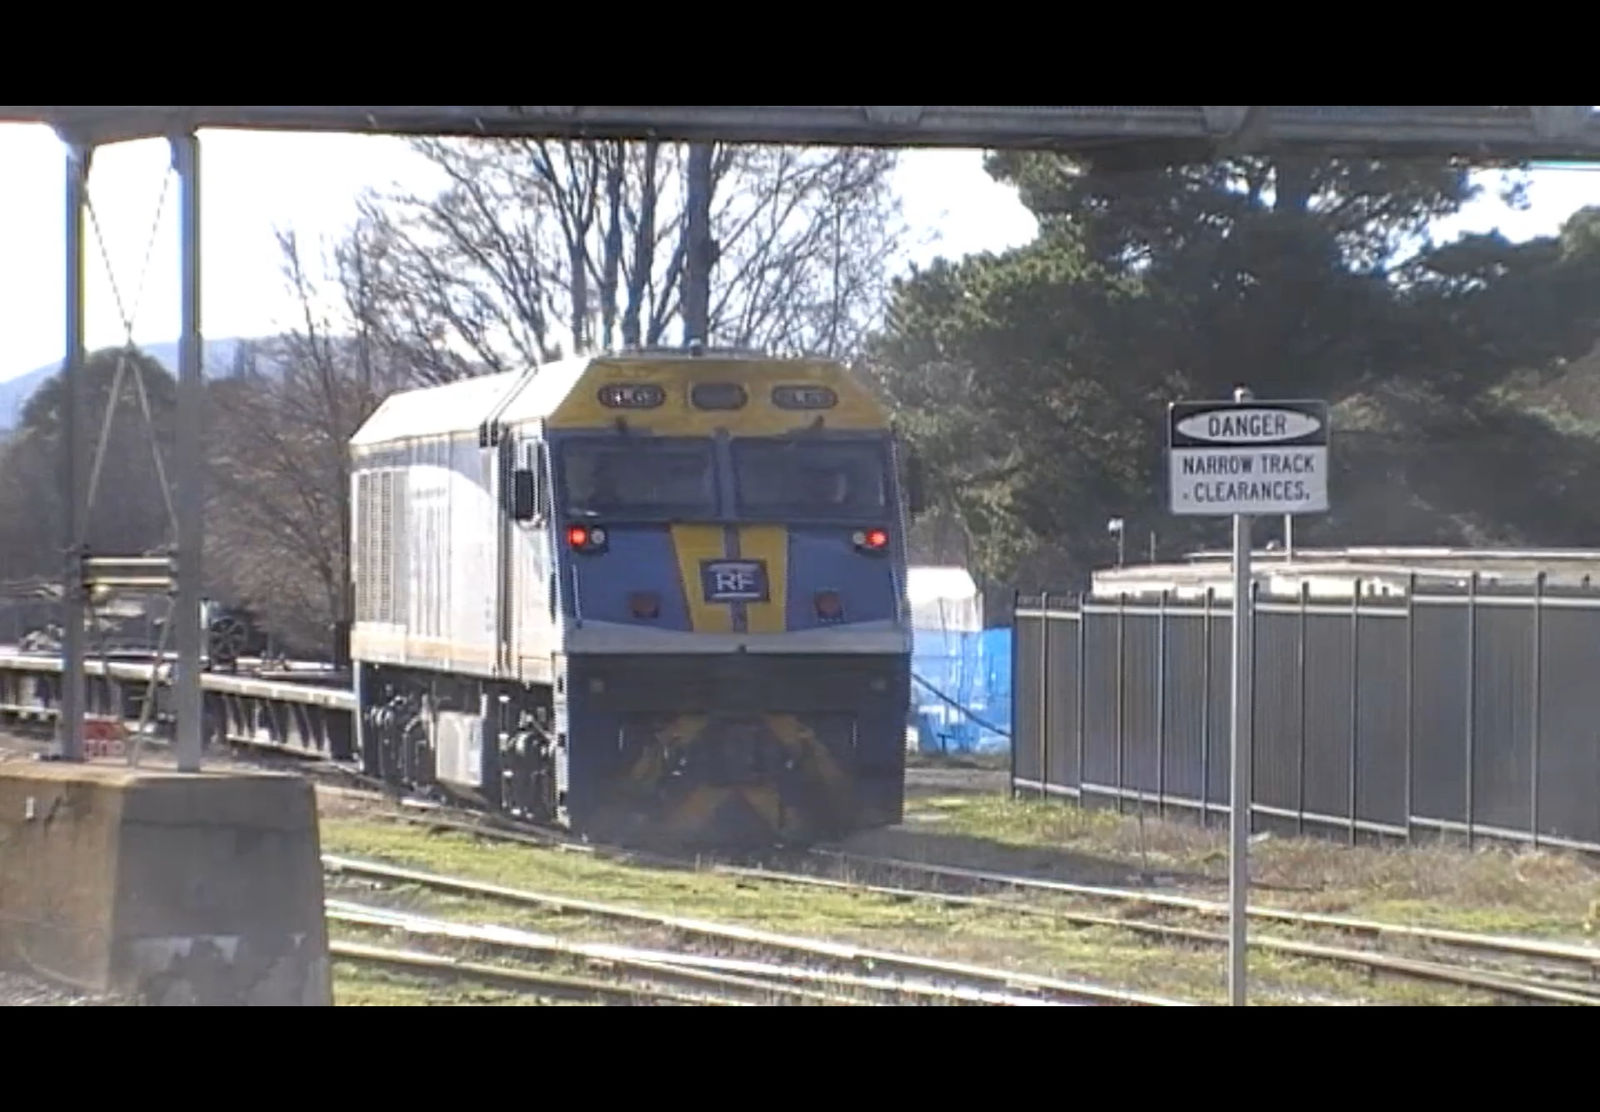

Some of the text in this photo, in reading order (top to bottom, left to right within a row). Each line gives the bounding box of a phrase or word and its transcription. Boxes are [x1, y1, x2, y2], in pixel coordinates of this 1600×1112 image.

[1208, 413, 1286, 437] DANGER
[1183, 453, 1314, 475] NARROW TRACK
